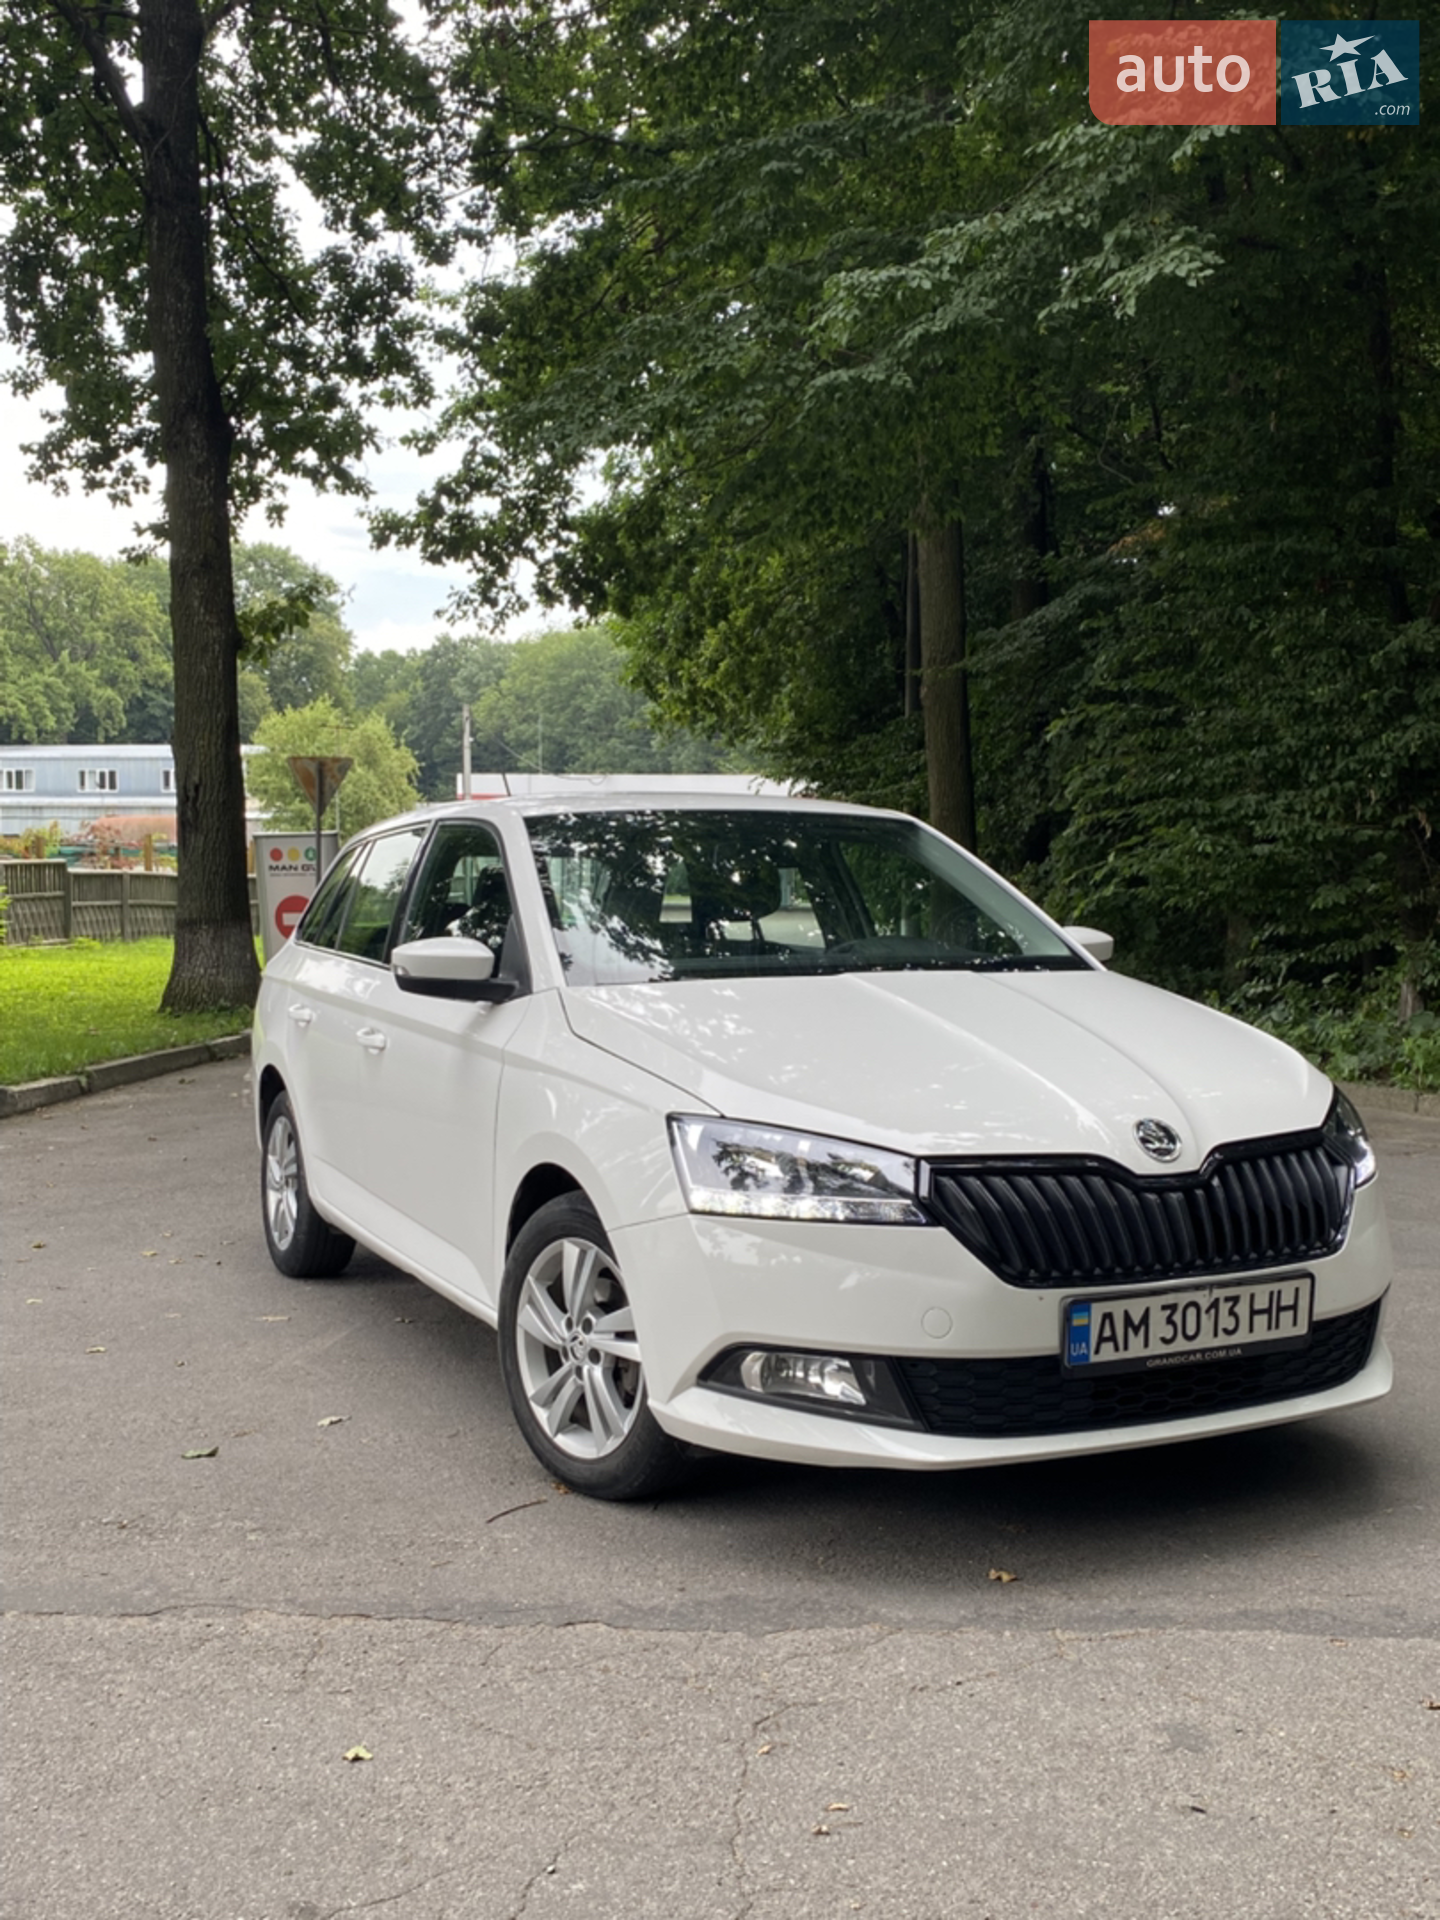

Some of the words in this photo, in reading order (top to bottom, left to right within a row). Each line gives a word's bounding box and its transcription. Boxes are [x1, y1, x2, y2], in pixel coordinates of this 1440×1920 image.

[268, 864, 298, 872] MAN
[1094, 1306, 1150, 1355] AM
[1159, 1294, 1241, 1346] 3013
[1248, 1286, 1300, 1334] HH
[1070, 1342, 1088, 1356] UA
